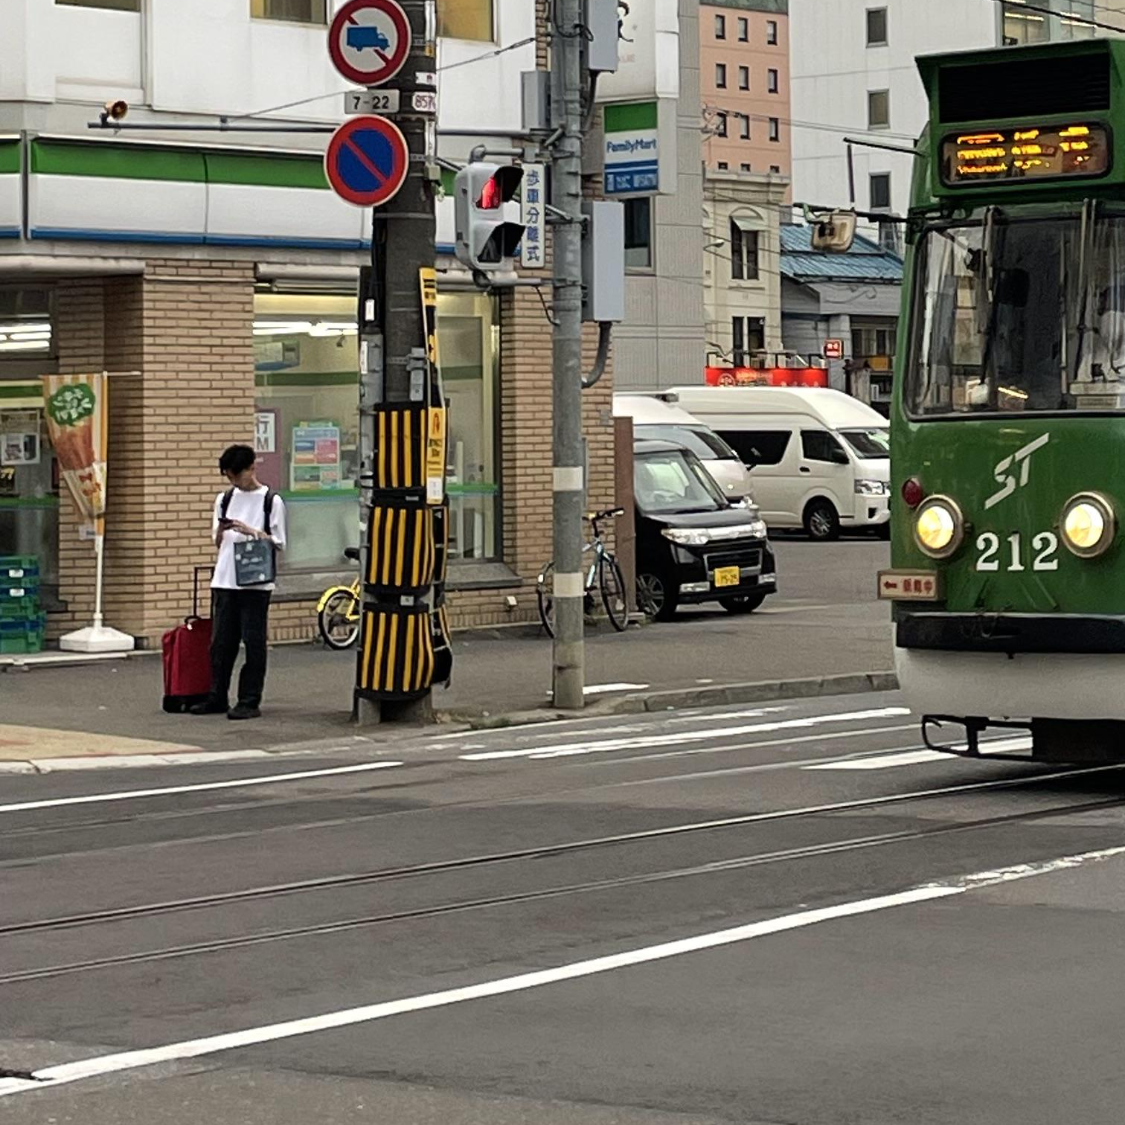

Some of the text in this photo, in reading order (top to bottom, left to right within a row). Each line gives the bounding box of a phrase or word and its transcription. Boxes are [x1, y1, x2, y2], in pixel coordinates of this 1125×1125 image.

[606, 138, 657, 154] FamilyMart
[526, 169, 540, 262] 歩車分離式
[976, 532, 1059, 572] 212
